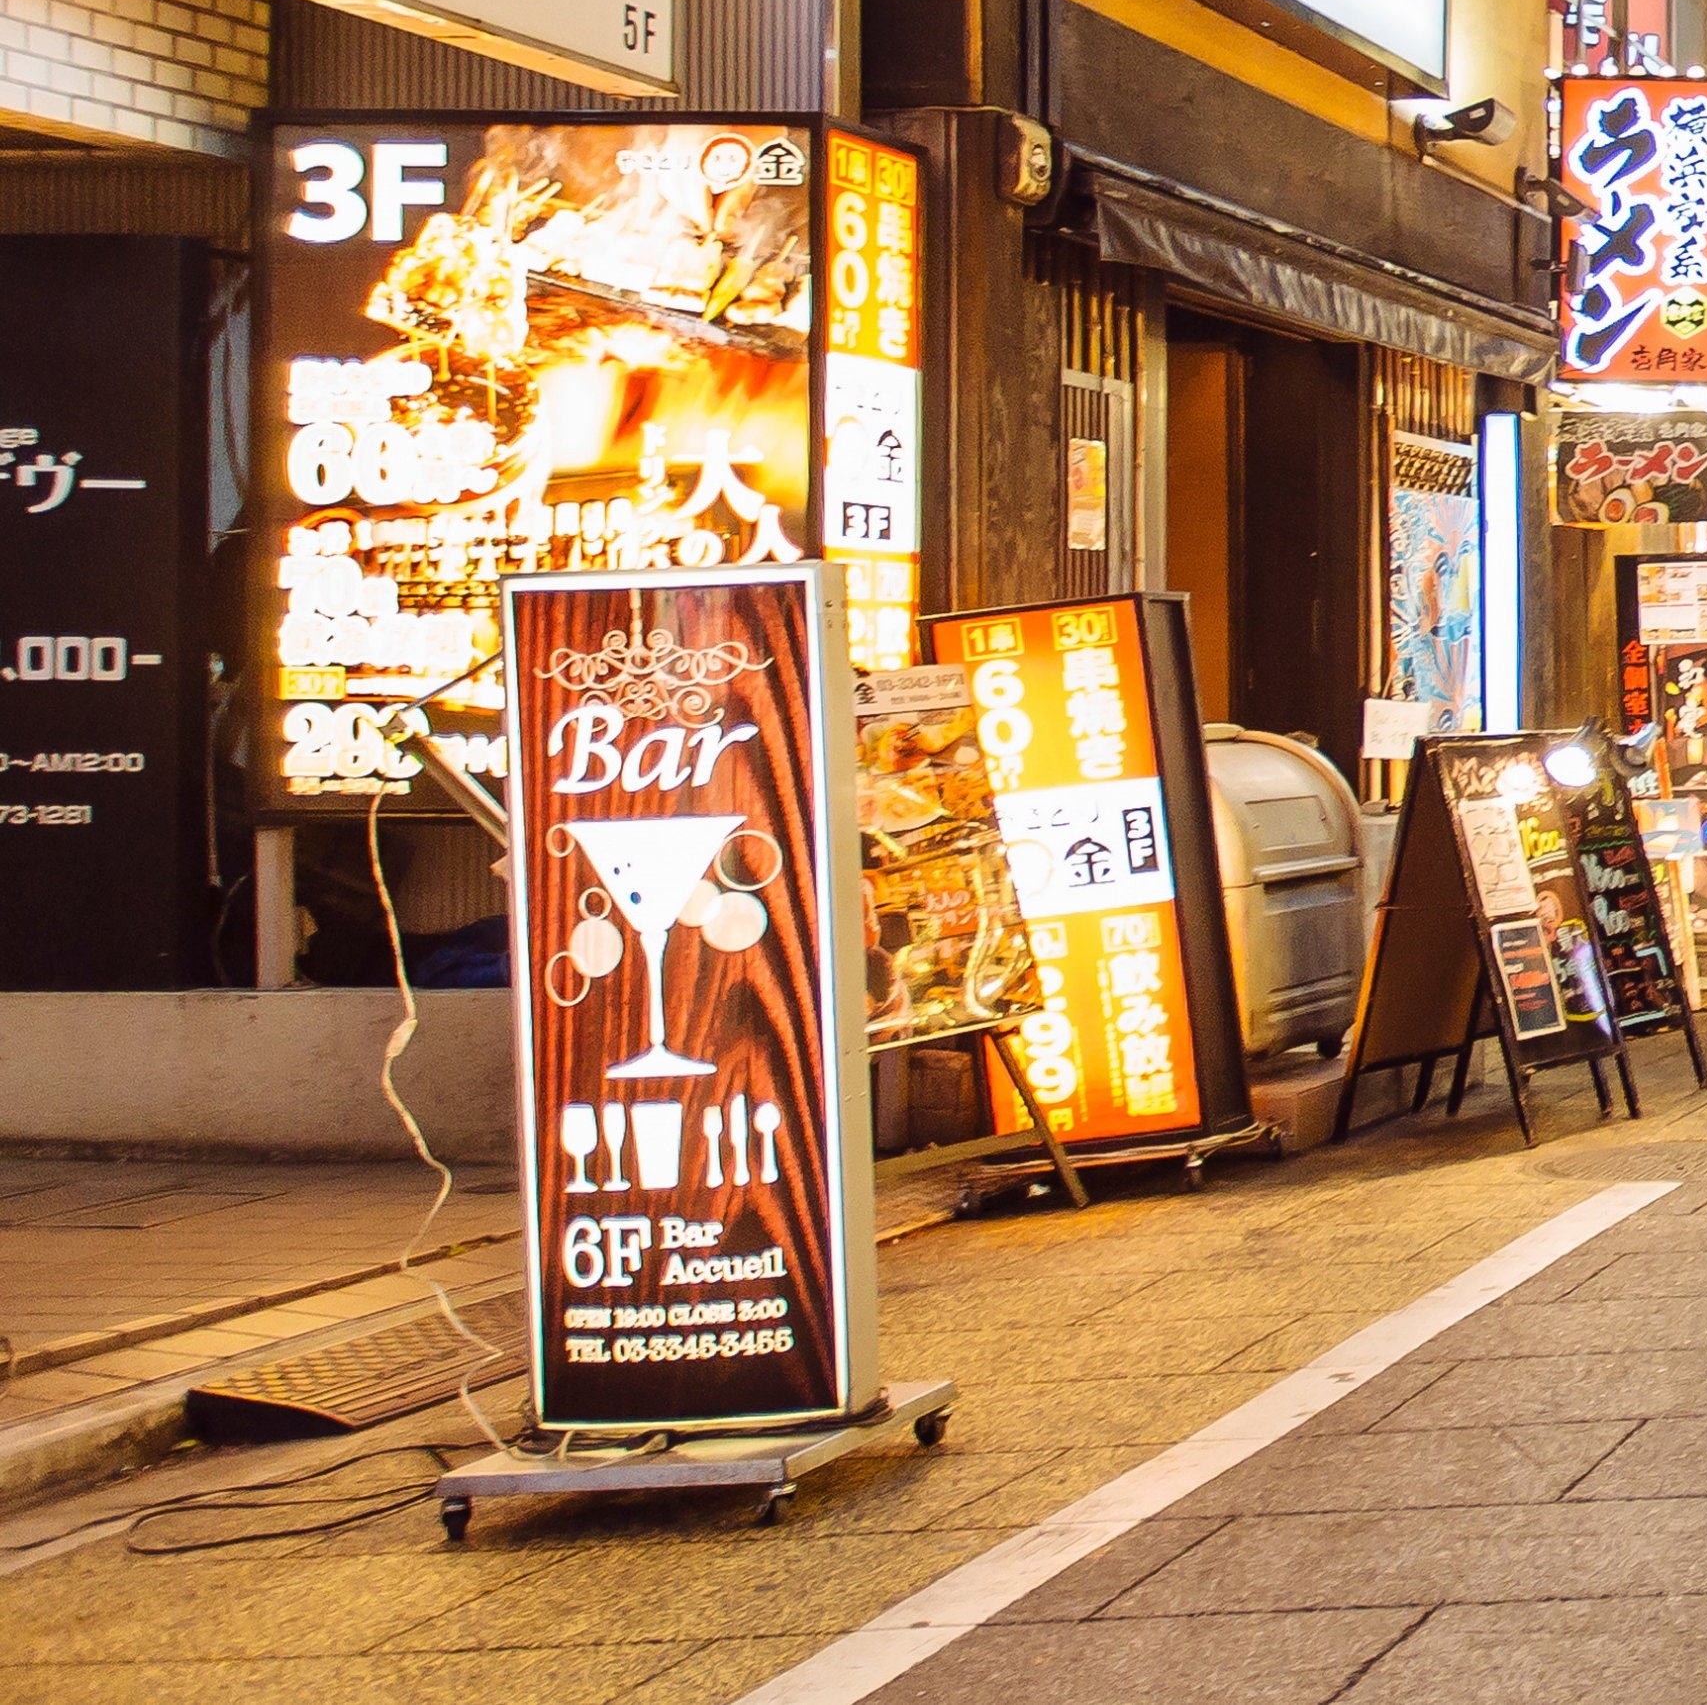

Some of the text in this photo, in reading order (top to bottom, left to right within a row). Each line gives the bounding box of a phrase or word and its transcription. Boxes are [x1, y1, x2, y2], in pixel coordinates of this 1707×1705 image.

[621, 3, 659, 56] 5F
[753, 136, 806, 186] 金
[284, 136, 450, 246] 3F
[1573, 95, 1661, 369] ラーメン
[0, 450, 148, 515] ヴー
[876, 429, 905, 484] 金
[845, 507, 889, 540] 3F
[1062, 648, 1128, 780] 串焼き
[549, 704, 759, 796] Bar
[1064, 836, 1117, 888] 金
[1125, 809, 1155, 868] 3F
[564, 1215, 652, 1289] 6F
[659, 1216, 724, 1250] Bar
[659, 1245, 788, 1286] Accueil
[563, 1305, 612, 1329] OPEN
[667, 1299, 735, 1328] CLOSE
[736, 1296, 788, 1323] 3:00
[565, 1325, 794, 1364] TEL 03-3345-3455
